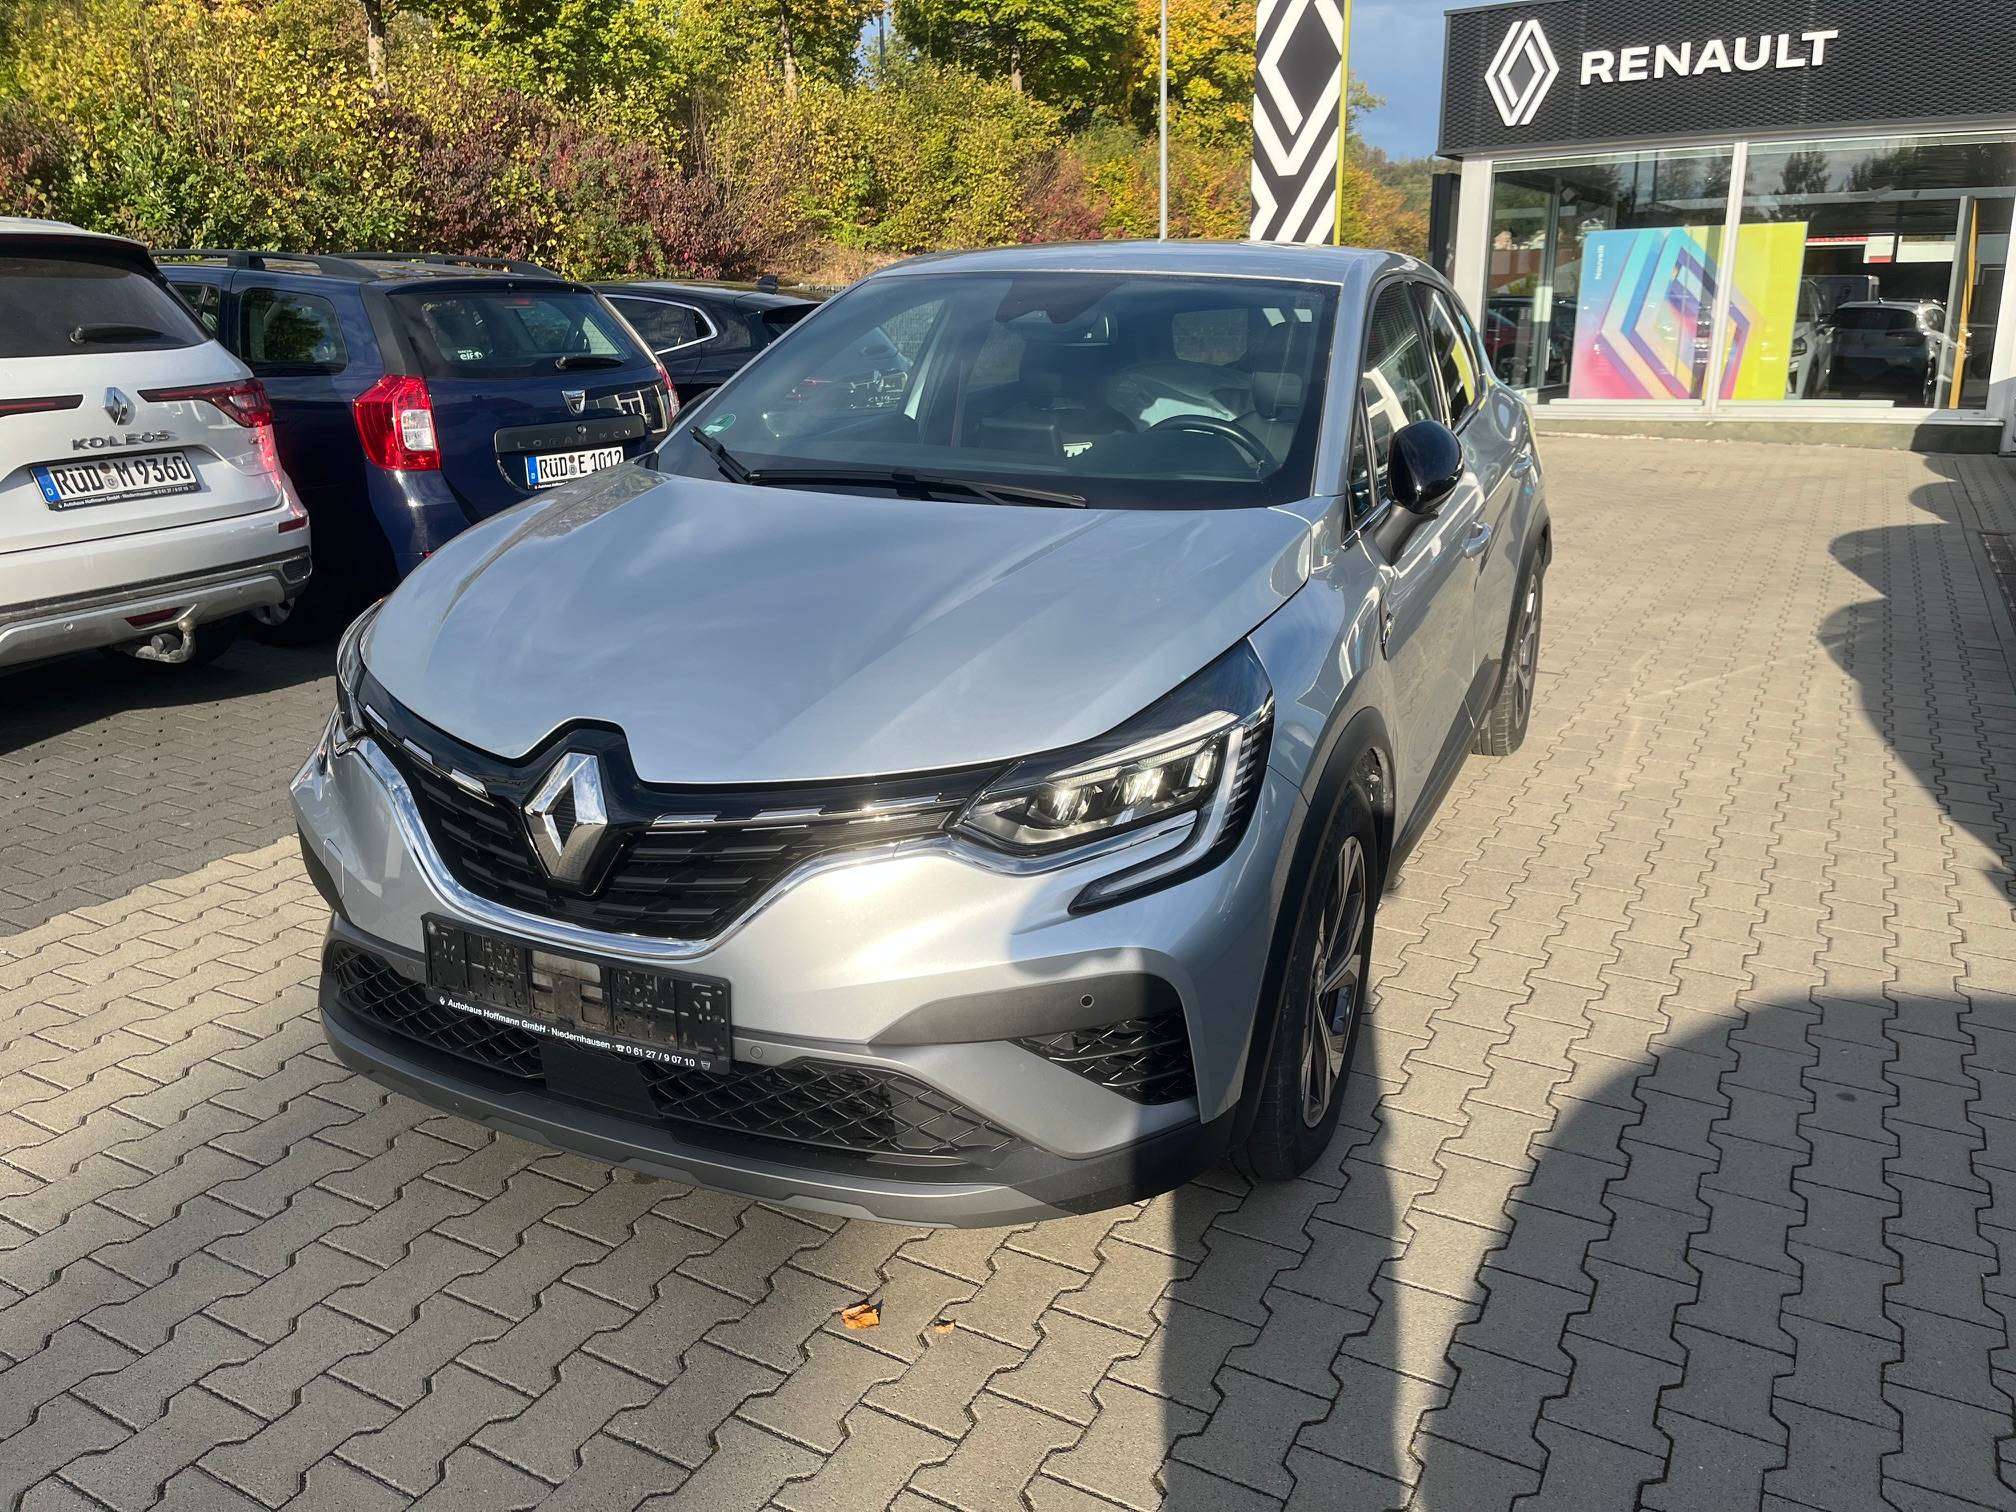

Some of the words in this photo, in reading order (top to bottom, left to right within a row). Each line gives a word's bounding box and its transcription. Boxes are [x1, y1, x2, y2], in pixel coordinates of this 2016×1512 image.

[1580, 30, 1838, 86] RENAULT
[72, 430, 170, 450] KOLEOS
[51, 464, 104, 496] RÜD
[113, 462, 136, 487] M
[134, 456, 191, 484] 9360
[540, 457, 568, 479] RÜD
[579, 455, 587, 474] E
[590, 450, 621, 472] 1012
[448, 999, 482, 1015] Autohaus
[483, 1009, 520, 1026] Hoffmann
[522, 1020, 546, 1033] GmbH
[552, 1028, 610, 1049] Niedernhausen
